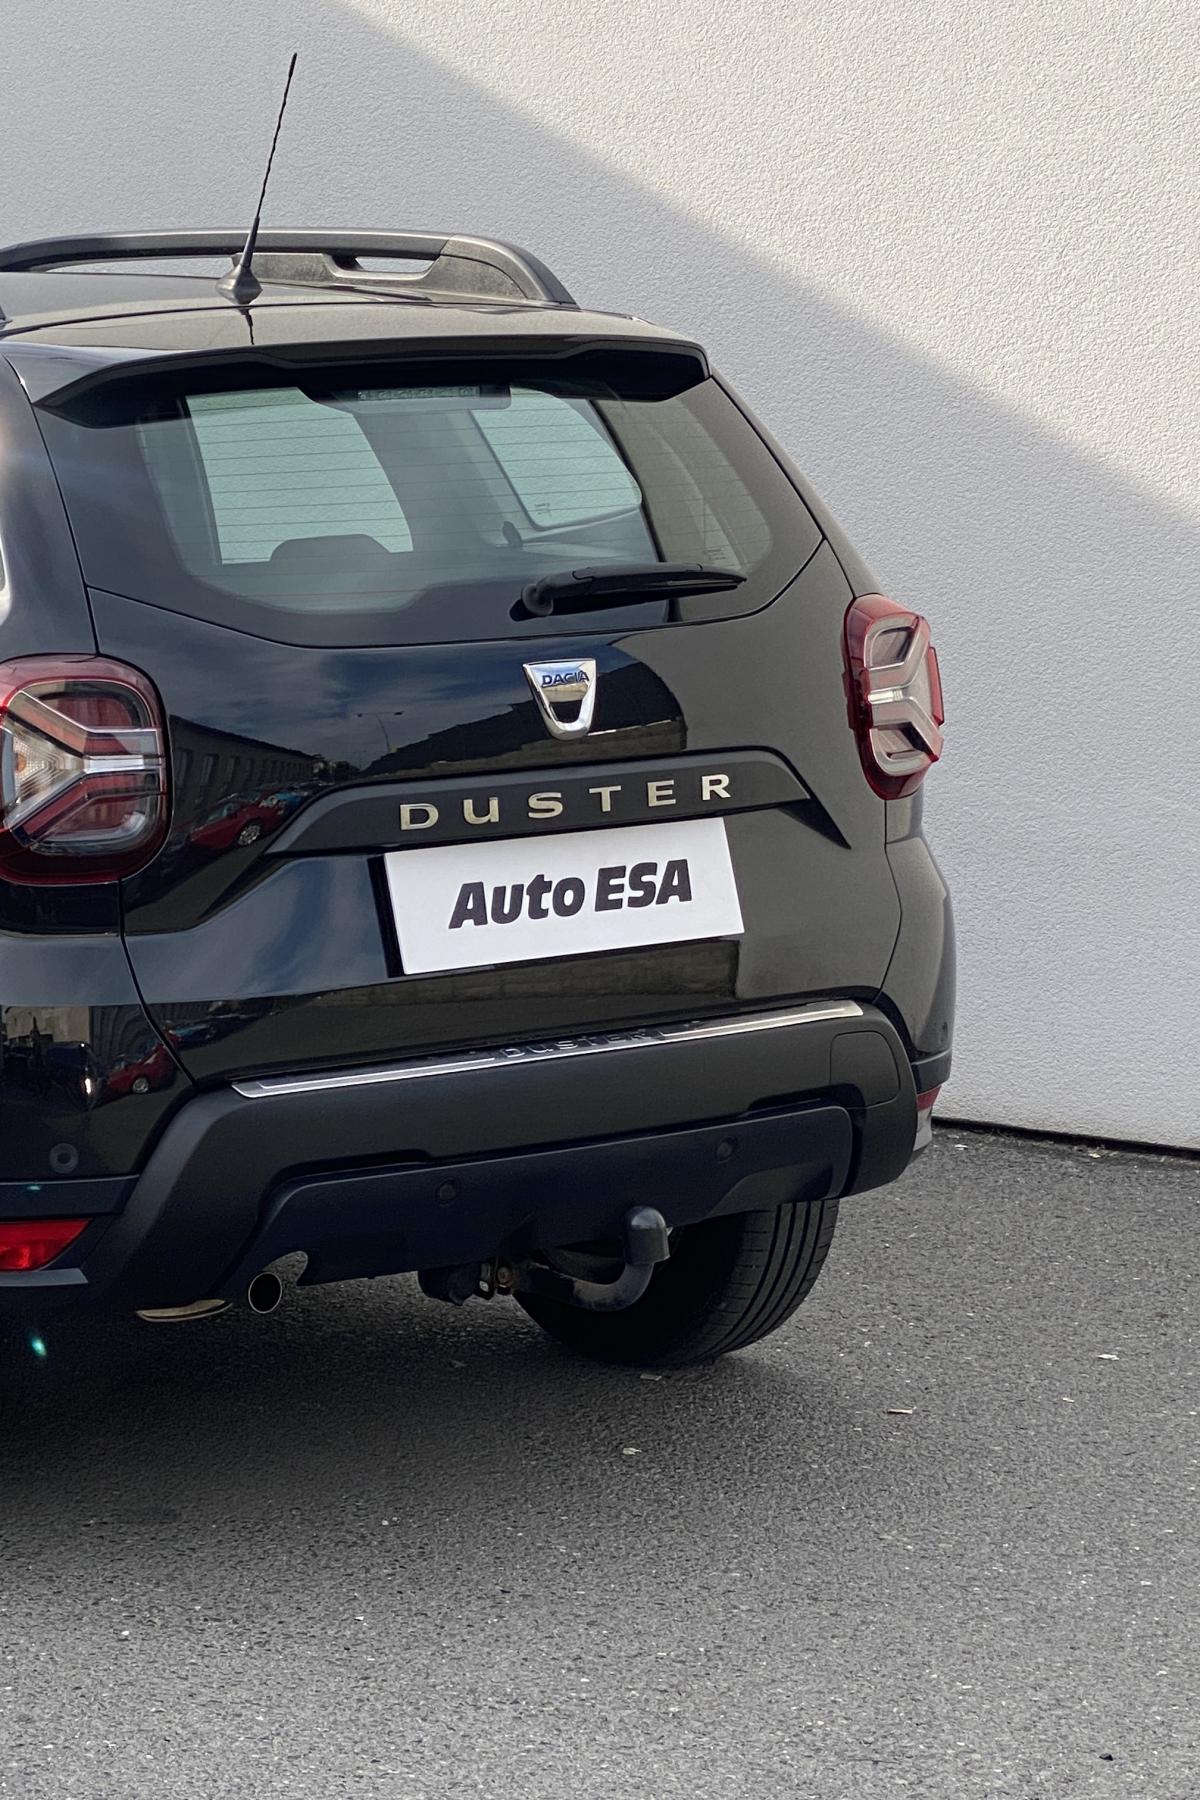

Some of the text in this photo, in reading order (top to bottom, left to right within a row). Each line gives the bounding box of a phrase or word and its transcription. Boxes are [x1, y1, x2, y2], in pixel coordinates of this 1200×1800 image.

[541, 670, 590, 685] DACIA
[399, 773, 731, 831] DUSTER
[447, 858, 692, 929] Auto ESA
[501, 1028, 646, 1058] DUSTER
